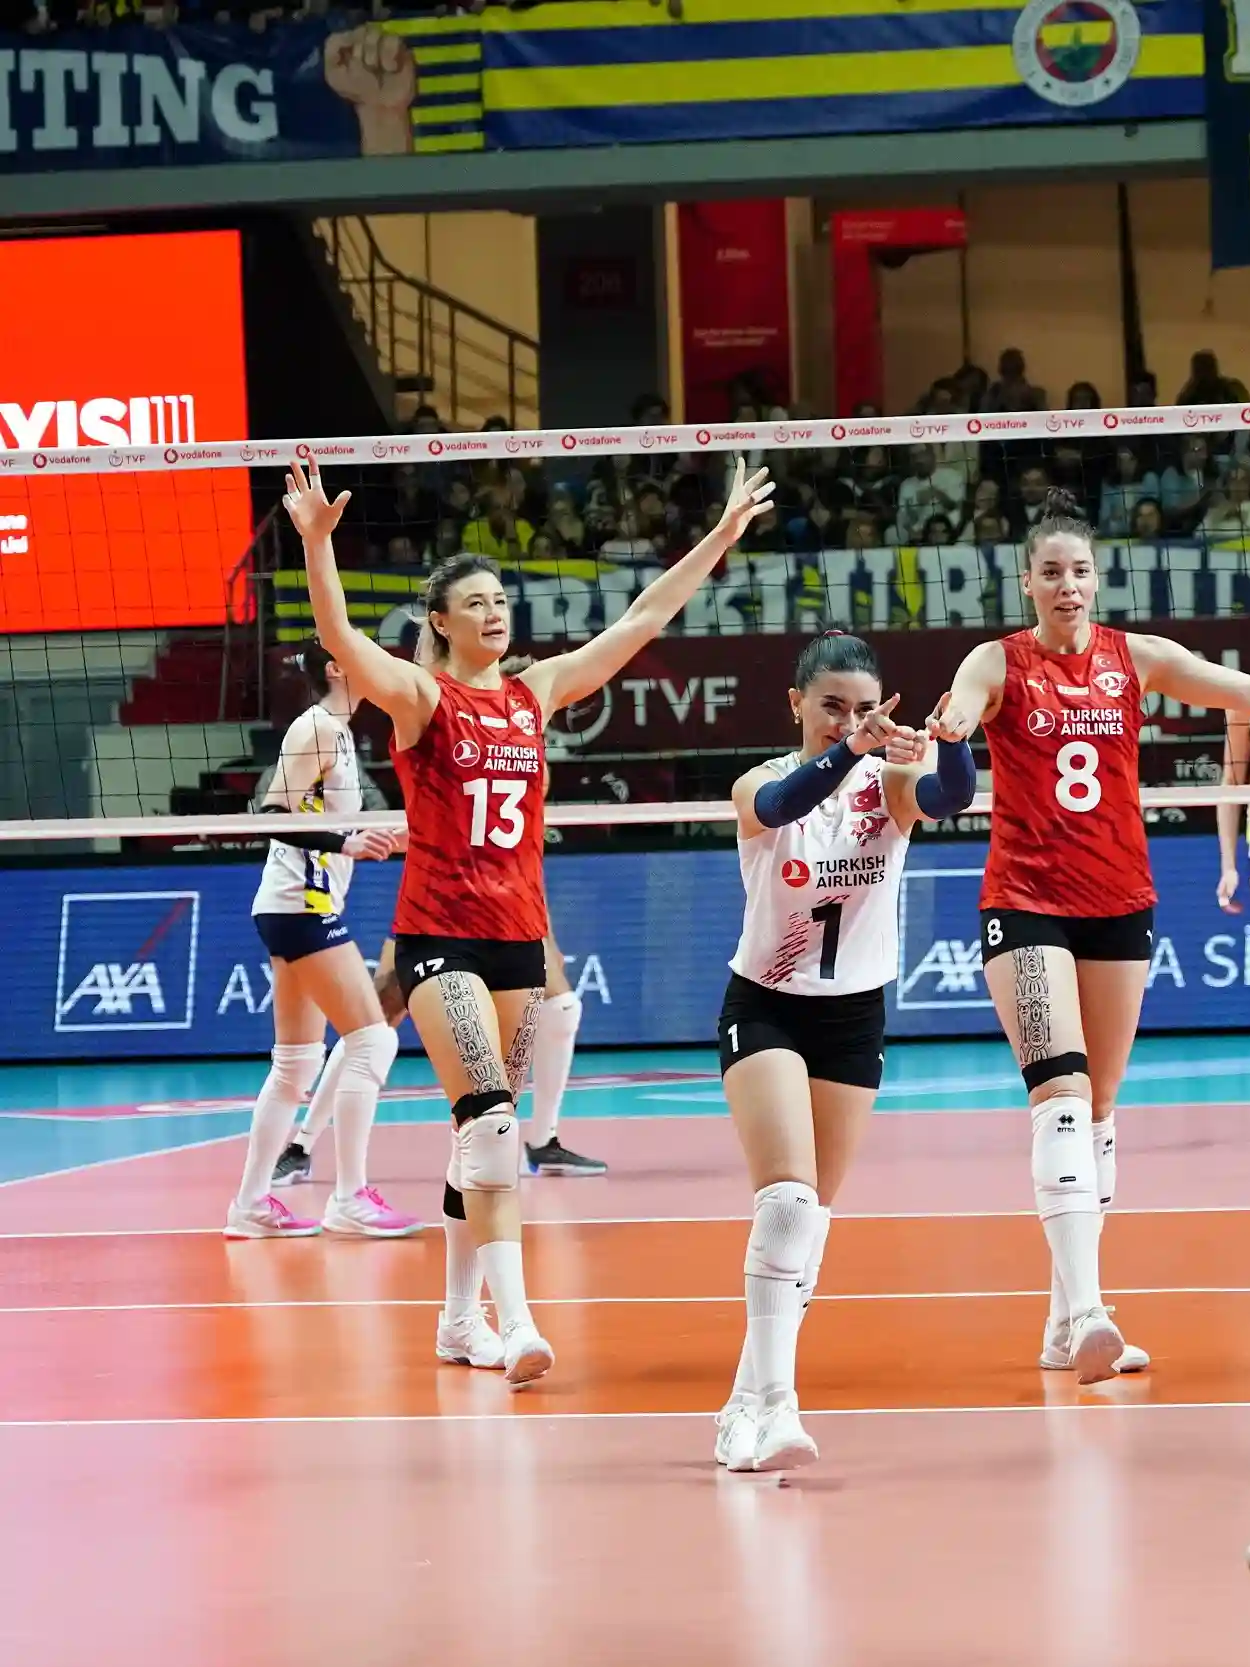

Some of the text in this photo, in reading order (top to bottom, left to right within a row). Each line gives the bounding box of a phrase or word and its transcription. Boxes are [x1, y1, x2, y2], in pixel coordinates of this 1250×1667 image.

[0, 455, 16, 468] VF
[48, 454, 92, 465] vodafone
[180, 448, 223, 461] vodafone
[311, 444, 355, 457] vodafone
[444, 440, 488, 451] vodafone
[577, 434, 622, 446] vodafone
[712, 430, 757, 441] vodafone
[847, 425, 892, 436] vodafone
[983, 418, 1028, 430] vodafone
[1120, 415, 1166, 425] vodafone
[622, 675, 739, 725] TVF
[1060, 708, 1123, 722] TURKISH
[1060, 722, 1124, 736] AIRLINES
[483, 758, 539, 774] AIRLINES
[485, 744, 539, 760] TURKISH
[1055, 741, 1101, 812] 8
[462, 777, 528, 849] 13
[816, 855, 886, 874] TURKISH
[815, 870, 885, 890] AIRLINES
[811, 902, 844, 980] 1
[987, 918, 1002, 947] 8
[61, 962, 166, 1015] AXA
[727, 1023, 739, 1053] 1
